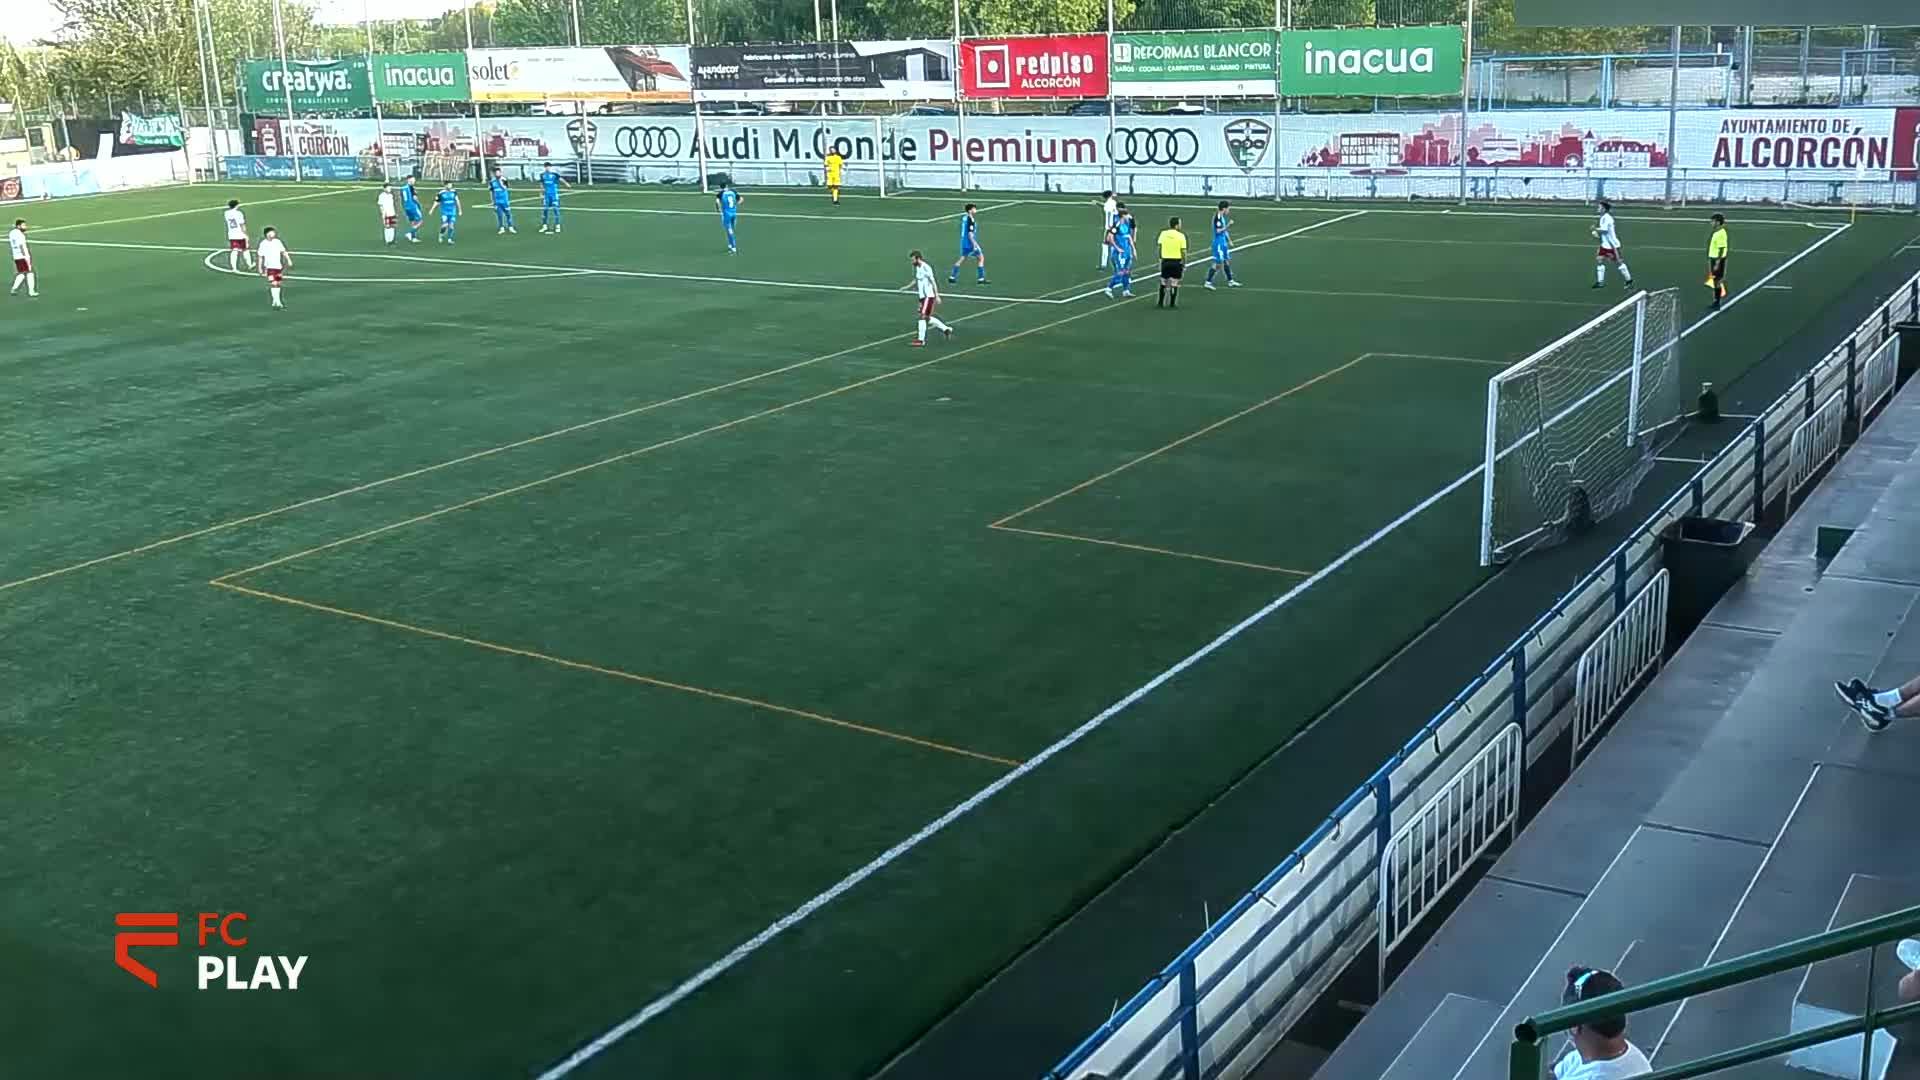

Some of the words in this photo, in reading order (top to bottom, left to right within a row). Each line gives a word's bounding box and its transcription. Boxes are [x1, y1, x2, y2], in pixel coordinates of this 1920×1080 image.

[1133, 44, 1199, 60] REFORMAS
[1204, 42, 1272, 58] BLANCOR
[1305, 41, 1433, 74] inacua
[384, 63, 455, 87] inacua
[1016, 52, 1093, 76] redpiso
[1021, 75, 1081, 89] ALCORCÓN
[1720, 118, 1828, 135] AYUNTAMIENTO
[1831, 118, 1850, 134] DE
[689, 127, 760, 160] Audi
[772, 127, 917, 162] M.Conde
[928, 128, 1097, 163] Premium
[1711, 127, 1890, 169] ALCORCÓN
